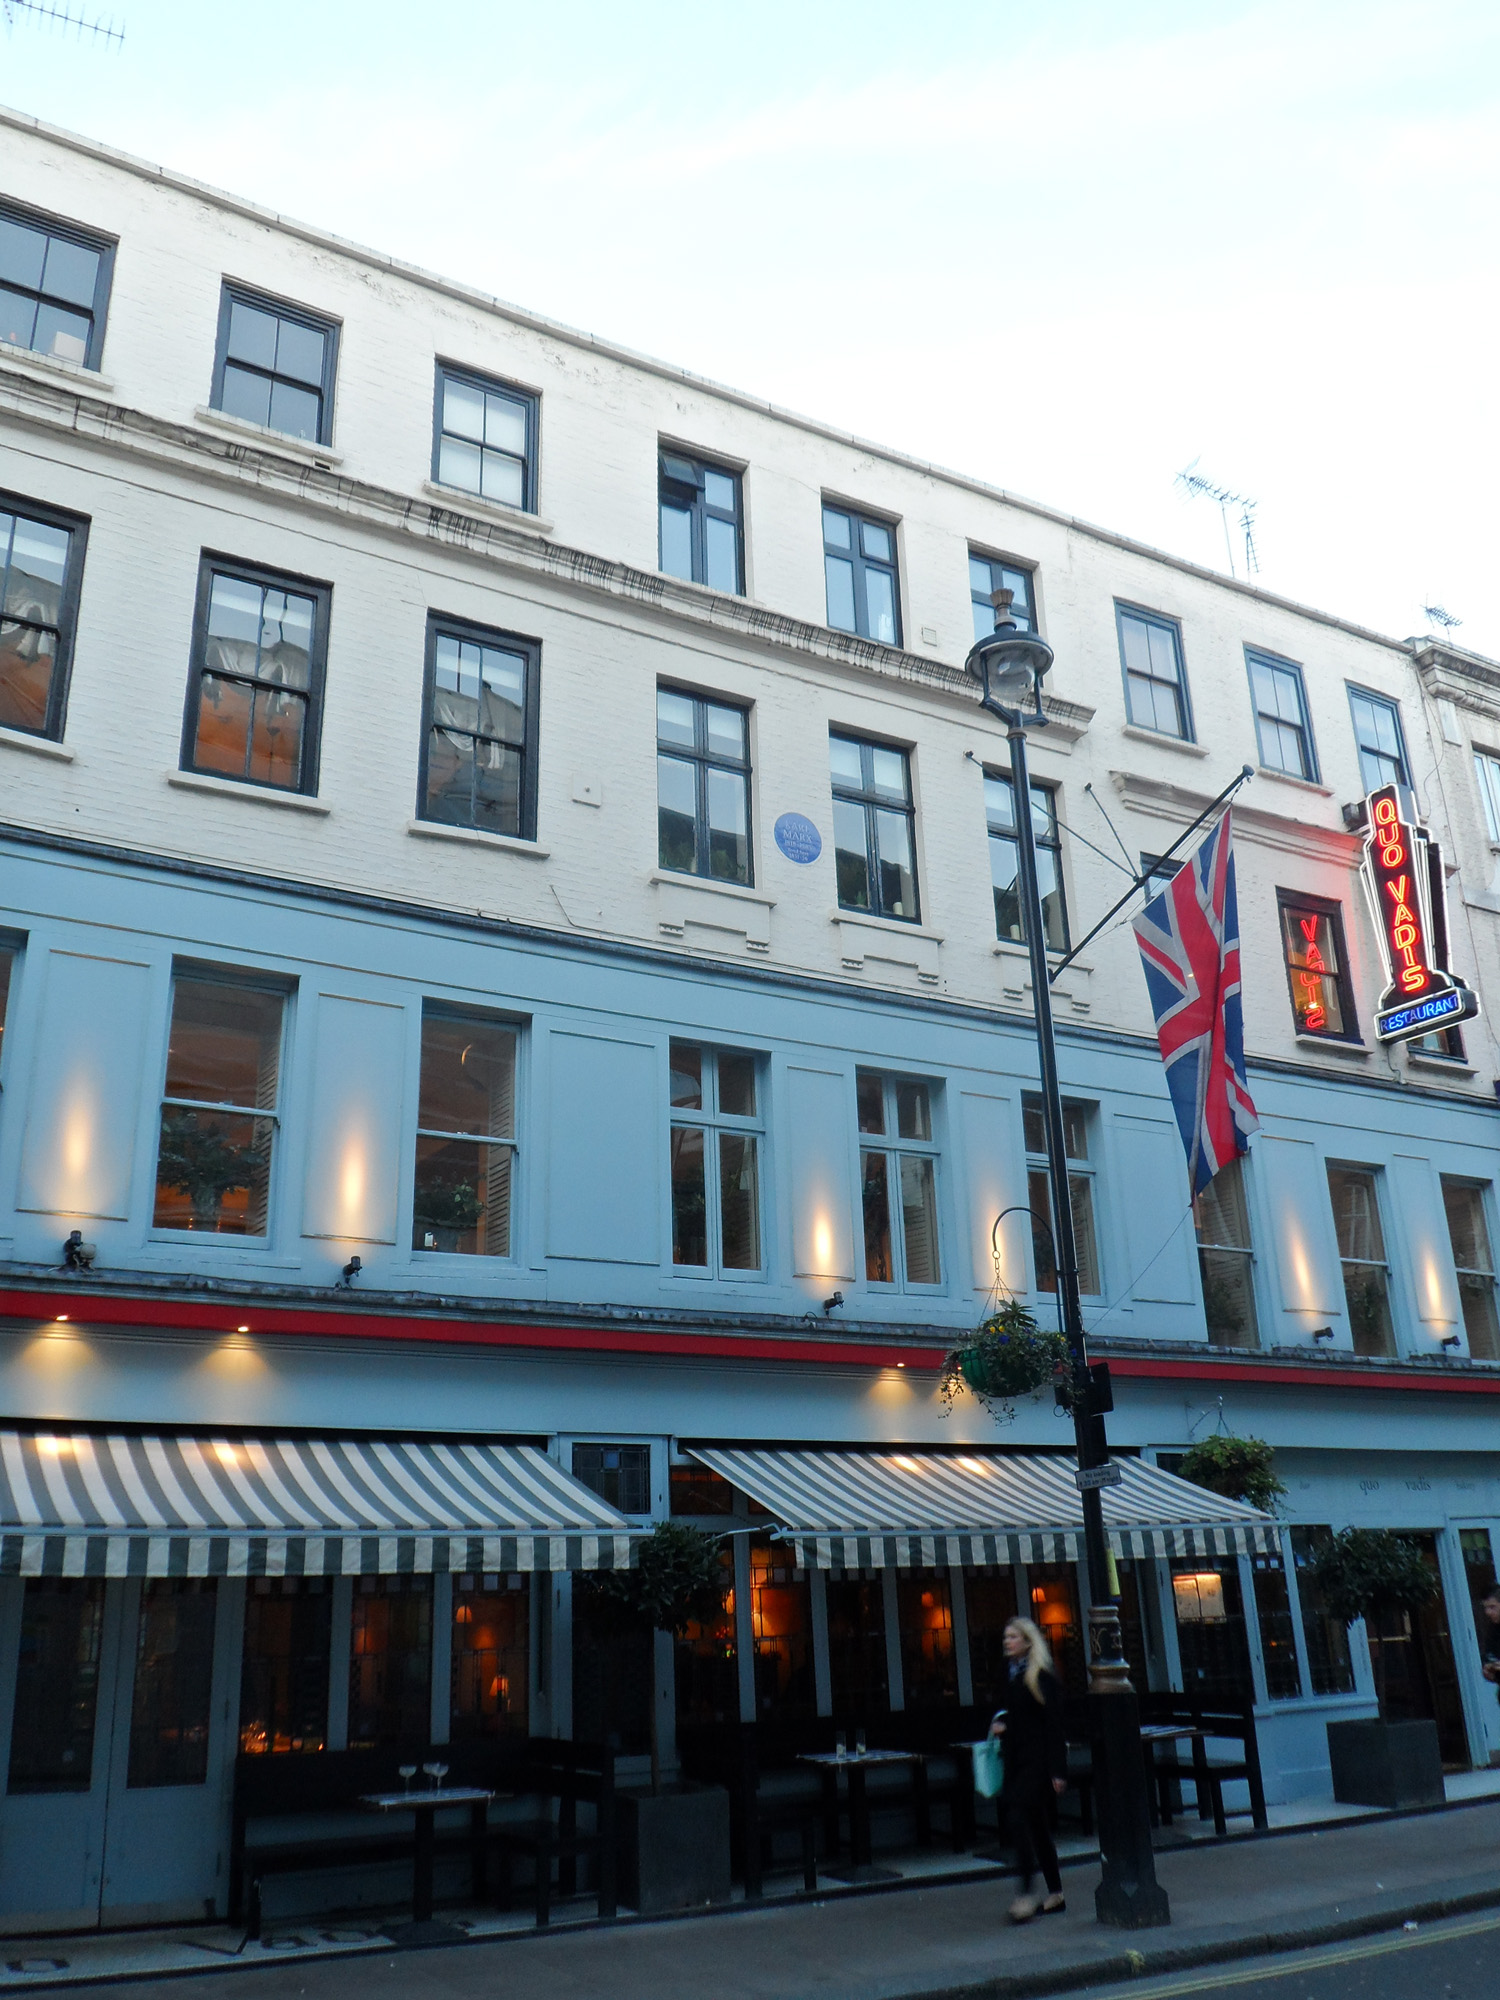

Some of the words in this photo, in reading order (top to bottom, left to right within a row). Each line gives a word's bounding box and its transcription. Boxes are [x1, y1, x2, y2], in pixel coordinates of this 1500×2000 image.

[783, 829, 812, 843] MARX
[1375, 797, 1405, 868] QUO
[1387, 874, 1425, 992] VADIS
[1380, 994, 1458, 1033] RESTAURANT
[1360, 1480, 1380, 1495] quo
[1404, 1476, 1431, 1491] vadis
